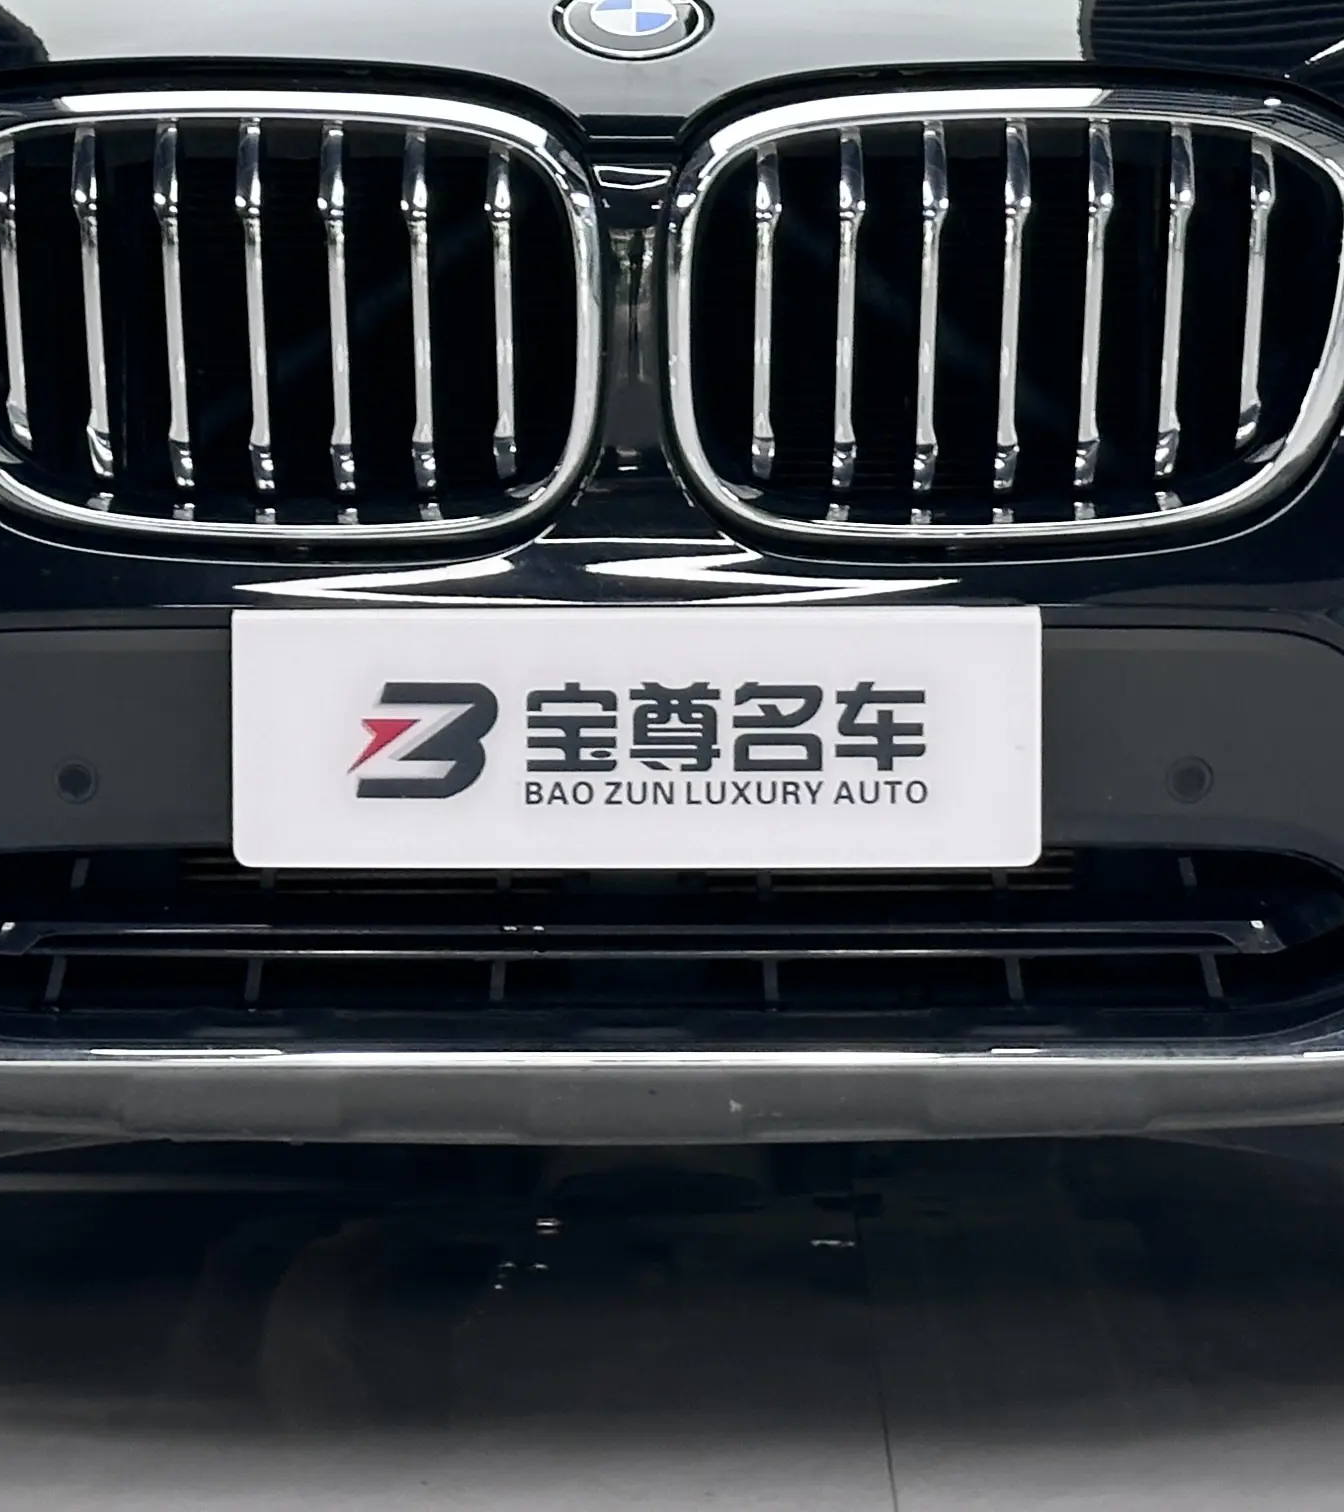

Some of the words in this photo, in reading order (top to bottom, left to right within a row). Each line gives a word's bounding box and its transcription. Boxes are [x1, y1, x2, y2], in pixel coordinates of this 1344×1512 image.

[525, 680, 927, 773] 宝尊名车
[524, 779, 594, 805] BAO
[603, 779, 674, 805] ZUN
[685, 779, 824, 805] LUXURY
[832, 779, 928, 805] AUTO
